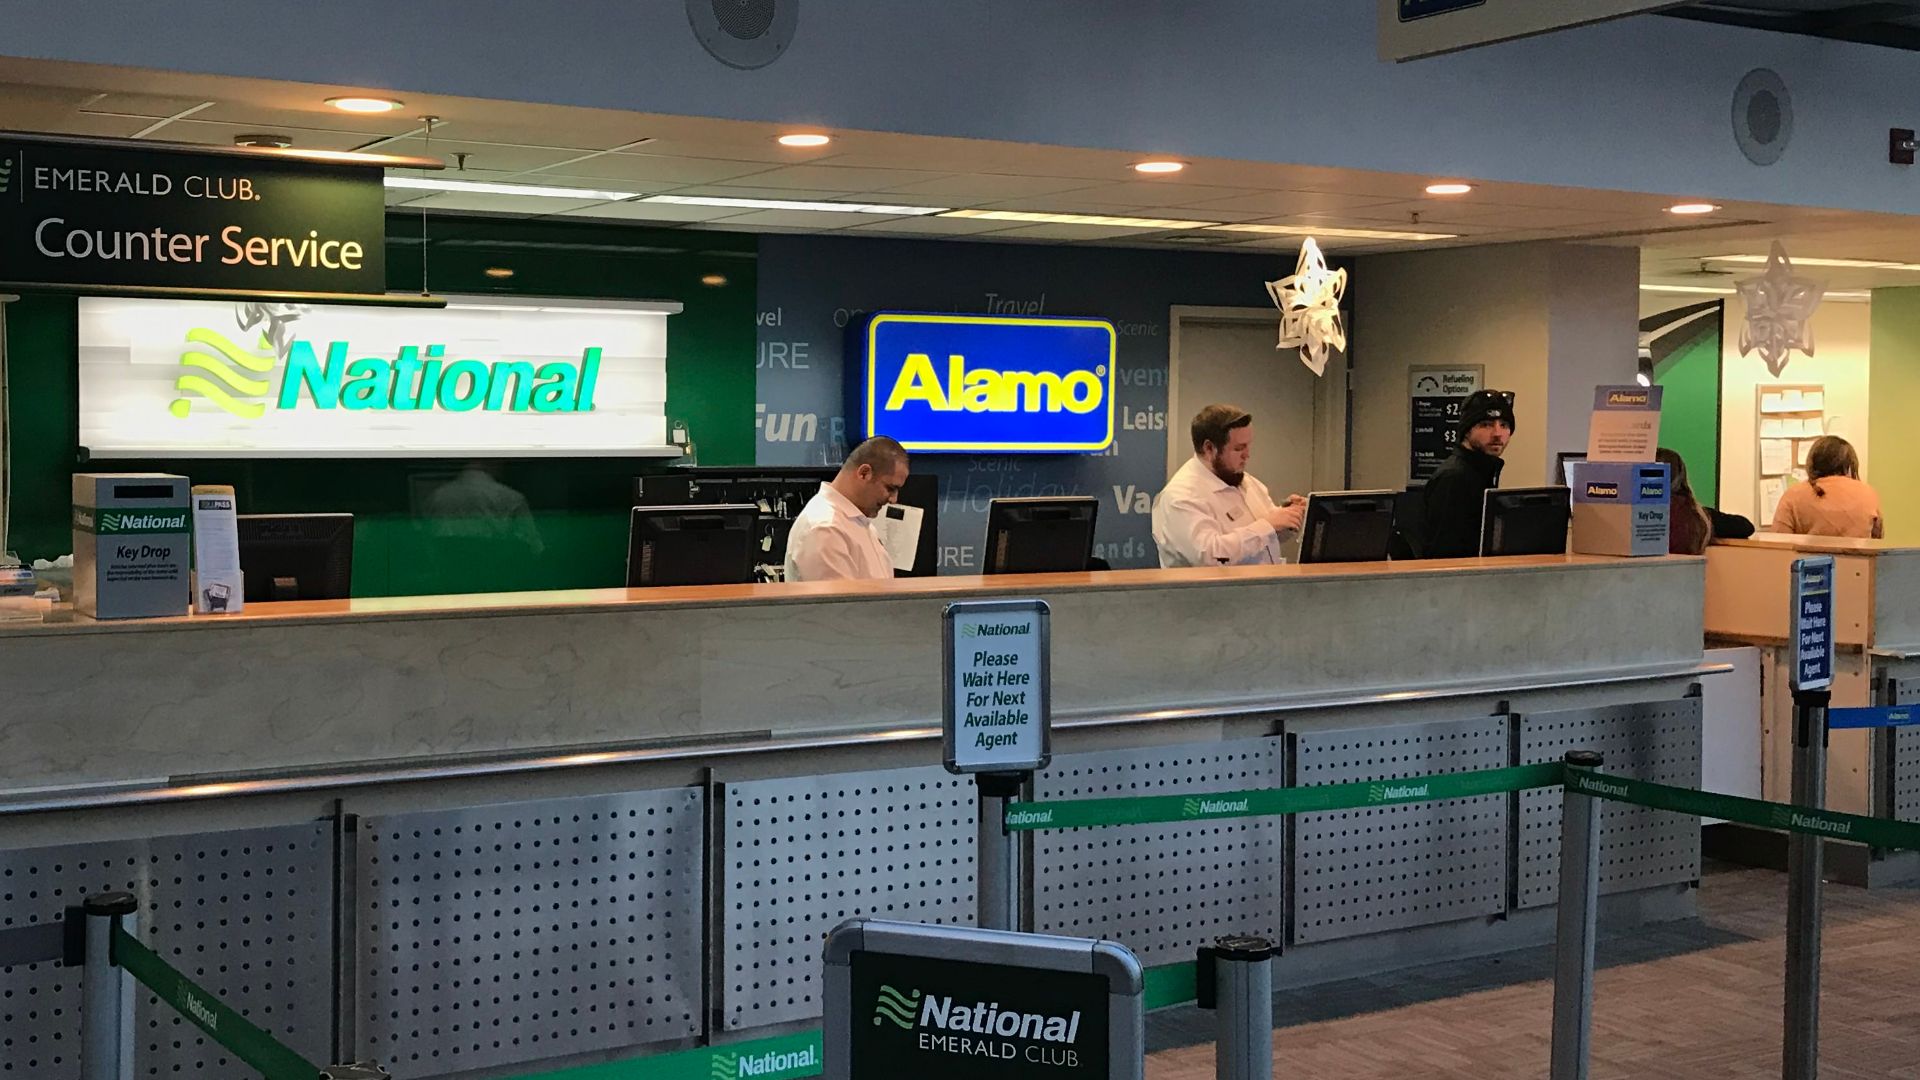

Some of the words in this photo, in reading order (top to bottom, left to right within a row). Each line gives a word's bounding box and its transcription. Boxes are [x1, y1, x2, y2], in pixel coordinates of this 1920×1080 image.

[34, 167, 172, 196] EMERALD
[35, 217, 210, 263] Counter
[220, 225, 364, 270] Service
[277, 340, 603, 412] National
[885, 353, 1104, 414] Alamo
[1442, 384, 1469, 395] Options
[1609, 393, 1648, 404] Alamo
[1123, 405, 1168, 430] Leis
[1588, 485, 1618, 495] Alamo
[120, 514, 186, 530] National
[117, 545, 140, 561] Key
[141, 545, 171, 560] Drop
[1804, 600, 1822, 614] Please
[977, 622, 1030, 636] National
[1812, 616, 1826, 628] Here
[1801, 633, 1811, 645] For
[1811, 631, 1824, 643] Next
[973, 651, 1019, 667] Please
[962, 672, 993, 688] Wait
[997, 670, 1030, 686] Here
[1804, 662, 1821, 678] Agent
[966, 691, 989, 708] For
[992, 690, 1026, 706] Next
[964, 710, 1029, 728] Available
[975, 731, 1018, 751] Agent
[1383, 784, 1429, 800] National
[1579, 776, 1628, 797] National
[1200, 798, 1249, 814] National
[1791, 813, 1851, 834] National
[186, 991, 217, 1030] National
[920, 994, 1081, 1044] National
[919, 1032, 1017, 1060] EMERALD
[1025, 1045, 1079, 1067] CLUB
[738, 1044, 815, 1078] National
